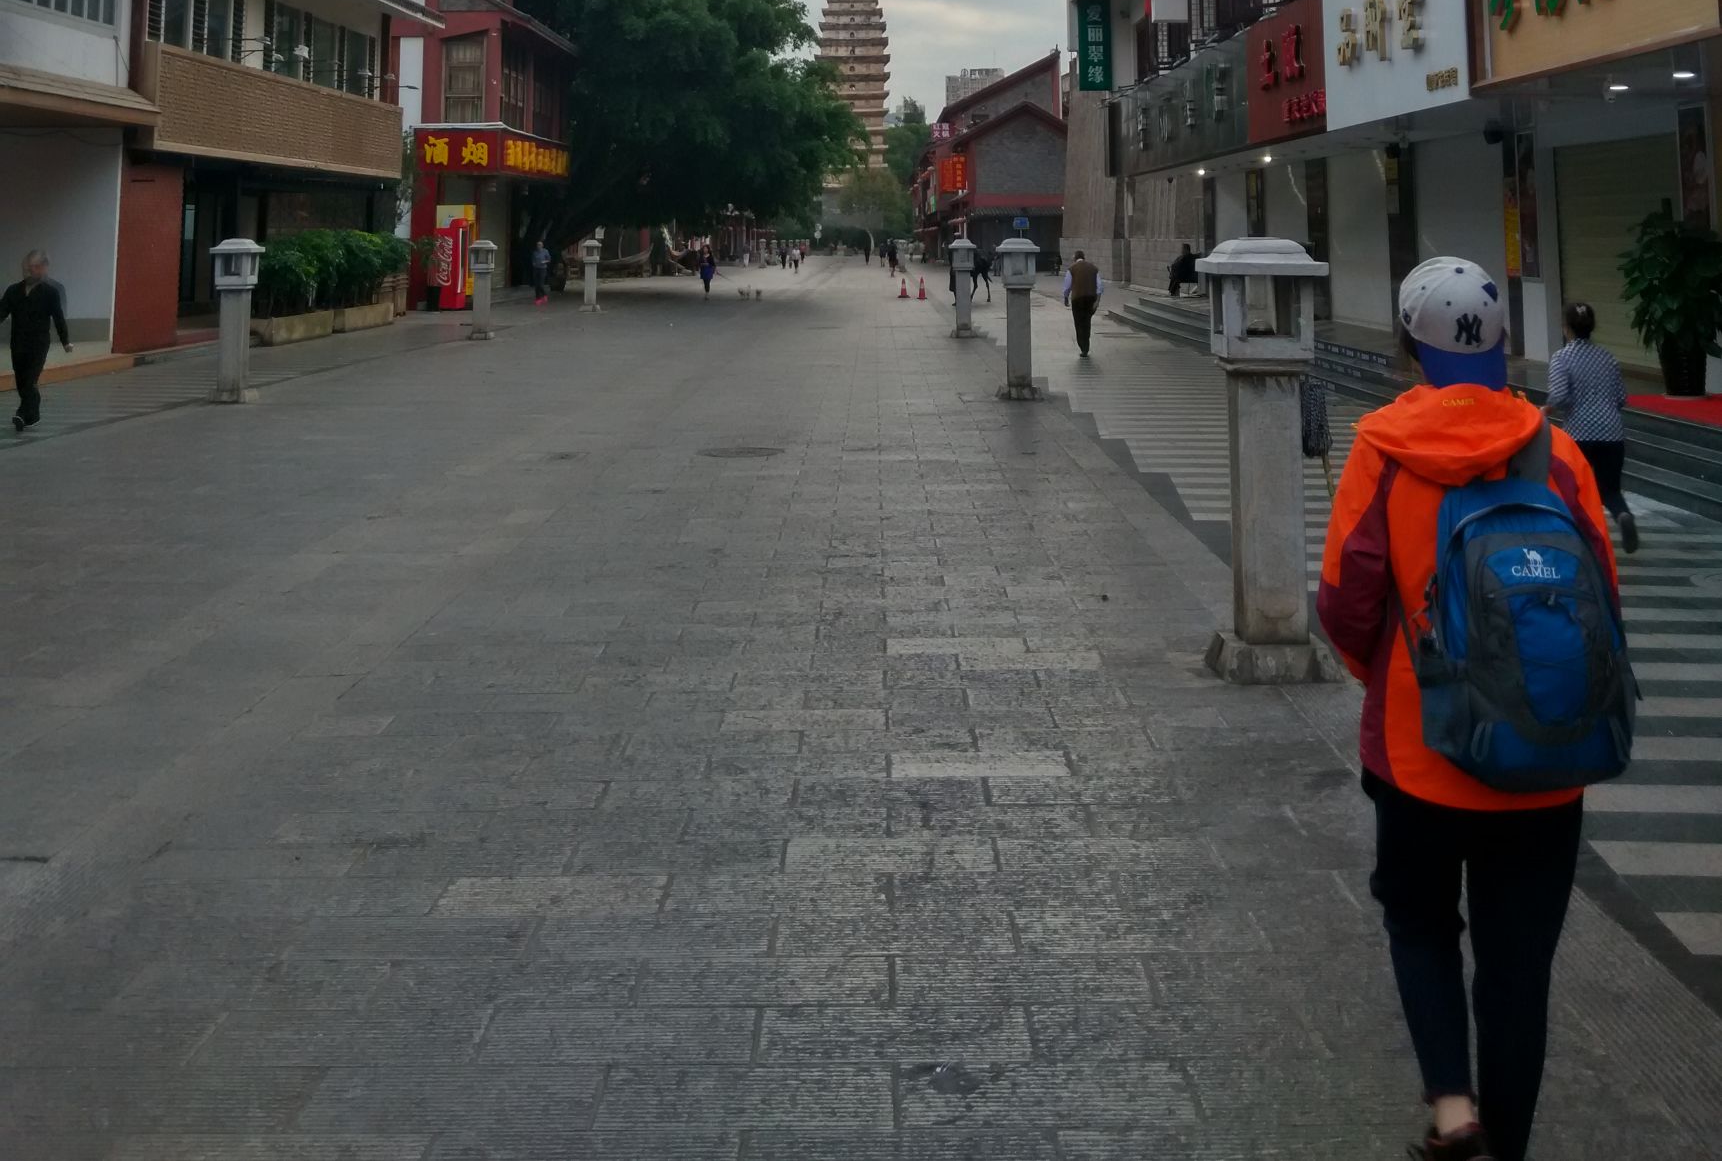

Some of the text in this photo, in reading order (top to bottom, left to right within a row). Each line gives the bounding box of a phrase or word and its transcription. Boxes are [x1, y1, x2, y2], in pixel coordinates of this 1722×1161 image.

[1086, 4, 1104, 84] 爱丽翠缘
[1511, 565, 1561, 579] CAMEL
